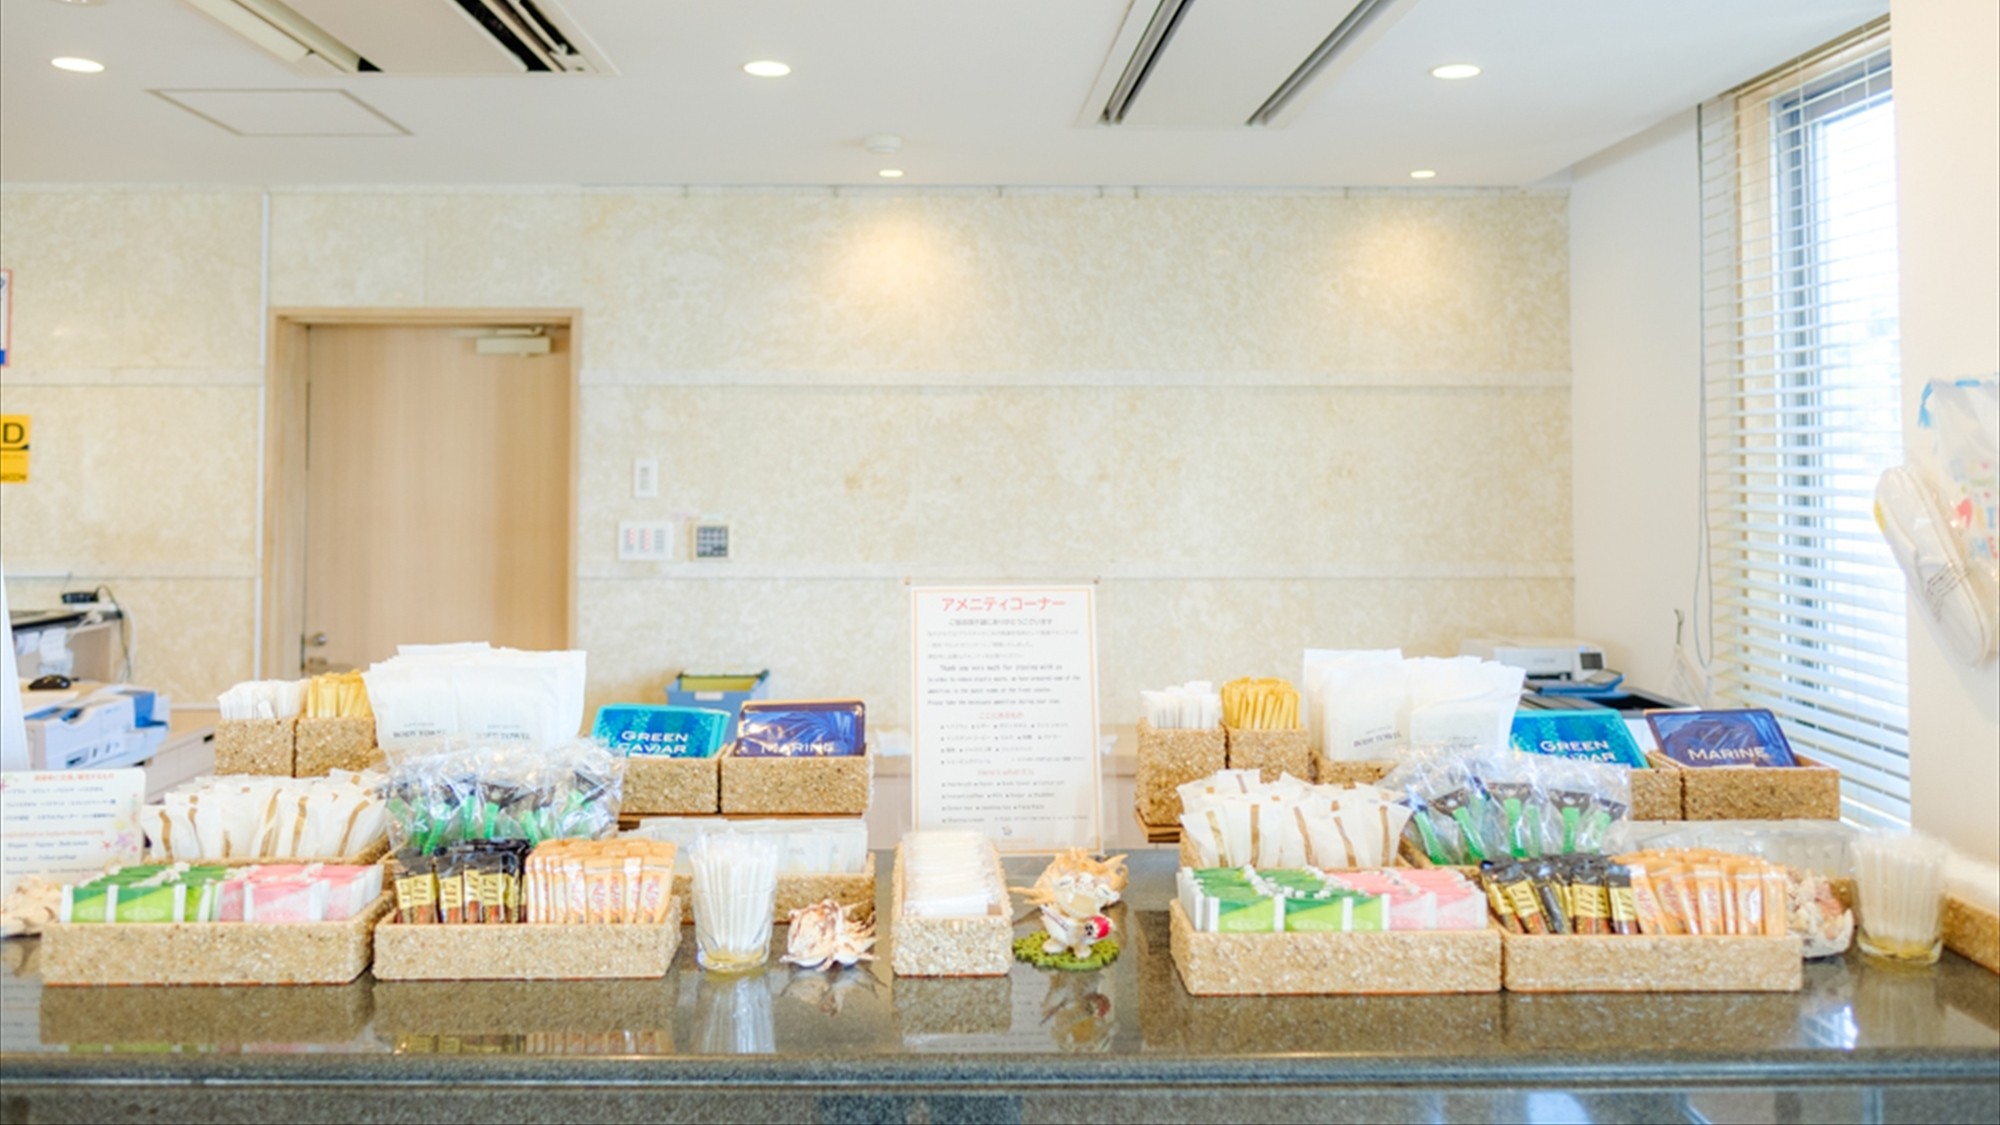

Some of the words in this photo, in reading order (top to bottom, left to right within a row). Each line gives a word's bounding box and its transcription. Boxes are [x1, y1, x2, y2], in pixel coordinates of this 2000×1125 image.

[941, 596, 1067, 612] アメニティコーナー
[621, 730, 689, 742] GREEN
[617, 743, 687, 754] CAVIAR
[760, 742, 836, 754] MARINE
[1540, 740, 1610, 752] GREEN
[1686, 746, 1767, 762] MARINE
